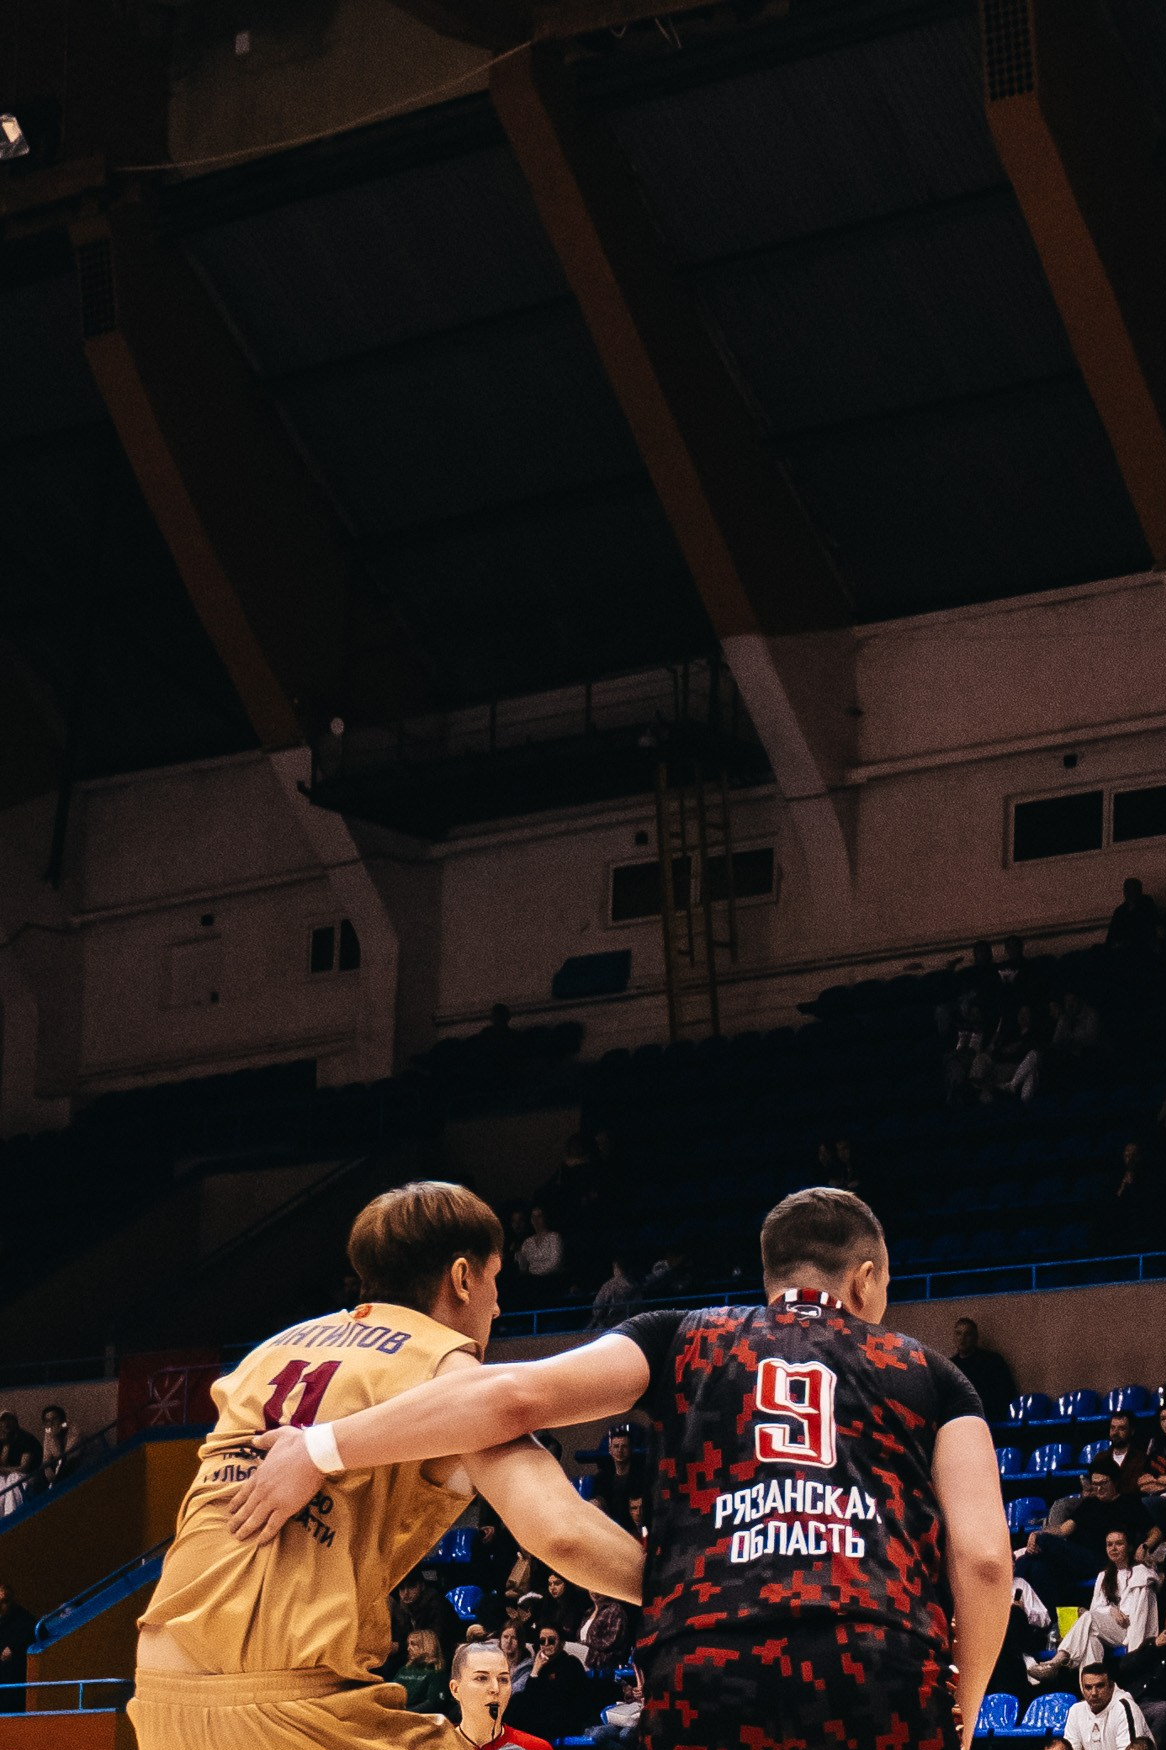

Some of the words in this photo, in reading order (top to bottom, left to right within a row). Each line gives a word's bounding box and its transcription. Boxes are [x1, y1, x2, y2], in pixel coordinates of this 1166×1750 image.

[263, 1359, 343, 1431] 11
[755, 1358, 837, 1469] 9
[715, 1479, 883, 1529] РЯЗАНСКАЯ
[730, 1521, 865, 1563] ОБЛАСТЬ
